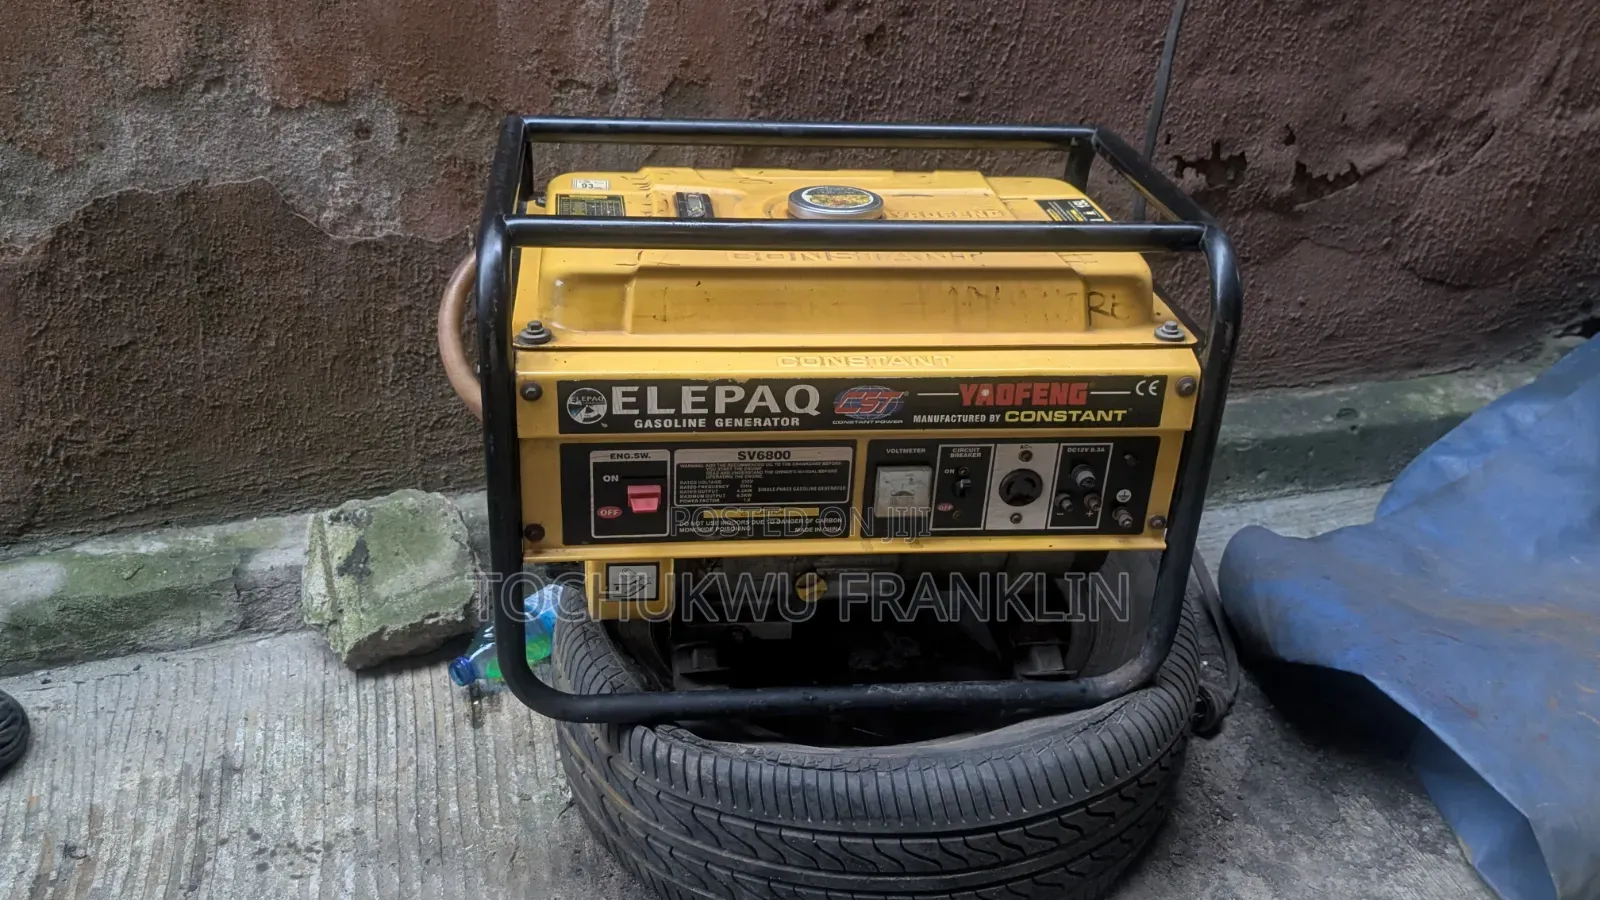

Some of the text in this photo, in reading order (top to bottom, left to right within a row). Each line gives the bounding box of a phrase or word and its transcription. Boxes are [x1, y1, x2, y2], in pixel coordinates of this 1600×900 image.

[776, 355, 953, 369] CONSTANT
[959, 382, 1089, 407] YAOFENG
[1135, 380, 1160, 396] CE
[611, 384, 821, 416] ELEPAQ
[634, 417, 800, 429] GASOLINE GENERATOR
[913, 409, 1128, 423] MANUFACTURED BY CONSTANT
[609, 452, 651, 460] ENG.SW.
[737, 450, 791, 461] SV6800
[602, 474, 619, 482] ON
